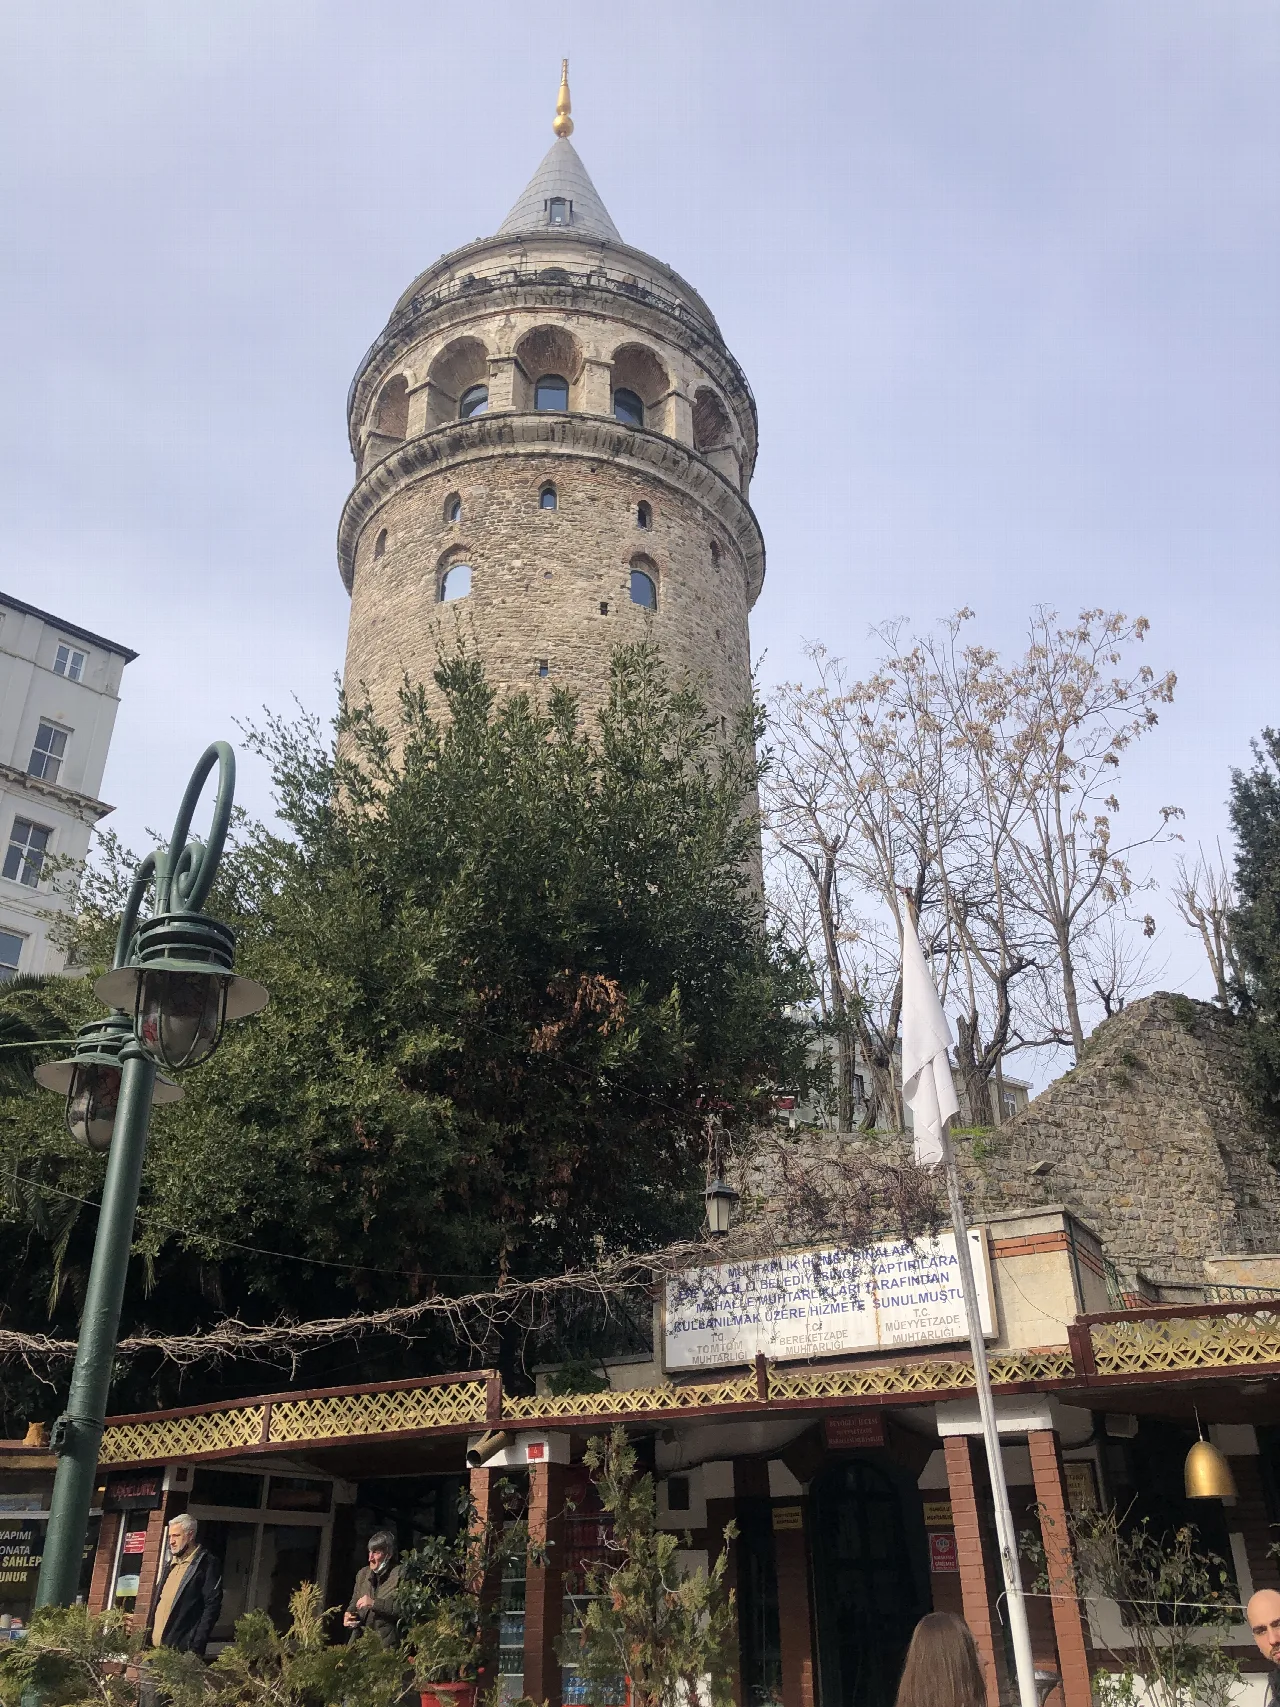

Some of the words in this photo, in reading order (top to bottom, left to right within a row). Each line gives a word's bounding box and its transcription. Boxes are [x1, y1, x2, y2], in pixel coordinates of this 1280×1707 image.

[913, 1308, 931, 1317] T.C.
[885, 1315, 960, 1332] MÜEYYETZADE
[779, 1329, 849, 1346] BEREKETZADE
[892, 1326, 954, 1343] MUHTARLIĞI
[697, 1340, 743, 1354] TOMTOM
[785, 1340, 845, 1355] MUHTARLIĞI
[692, 1349, 748, 1365] MUHTARLIĞI
[2, 1555, 42, 1568] SAHLEP
